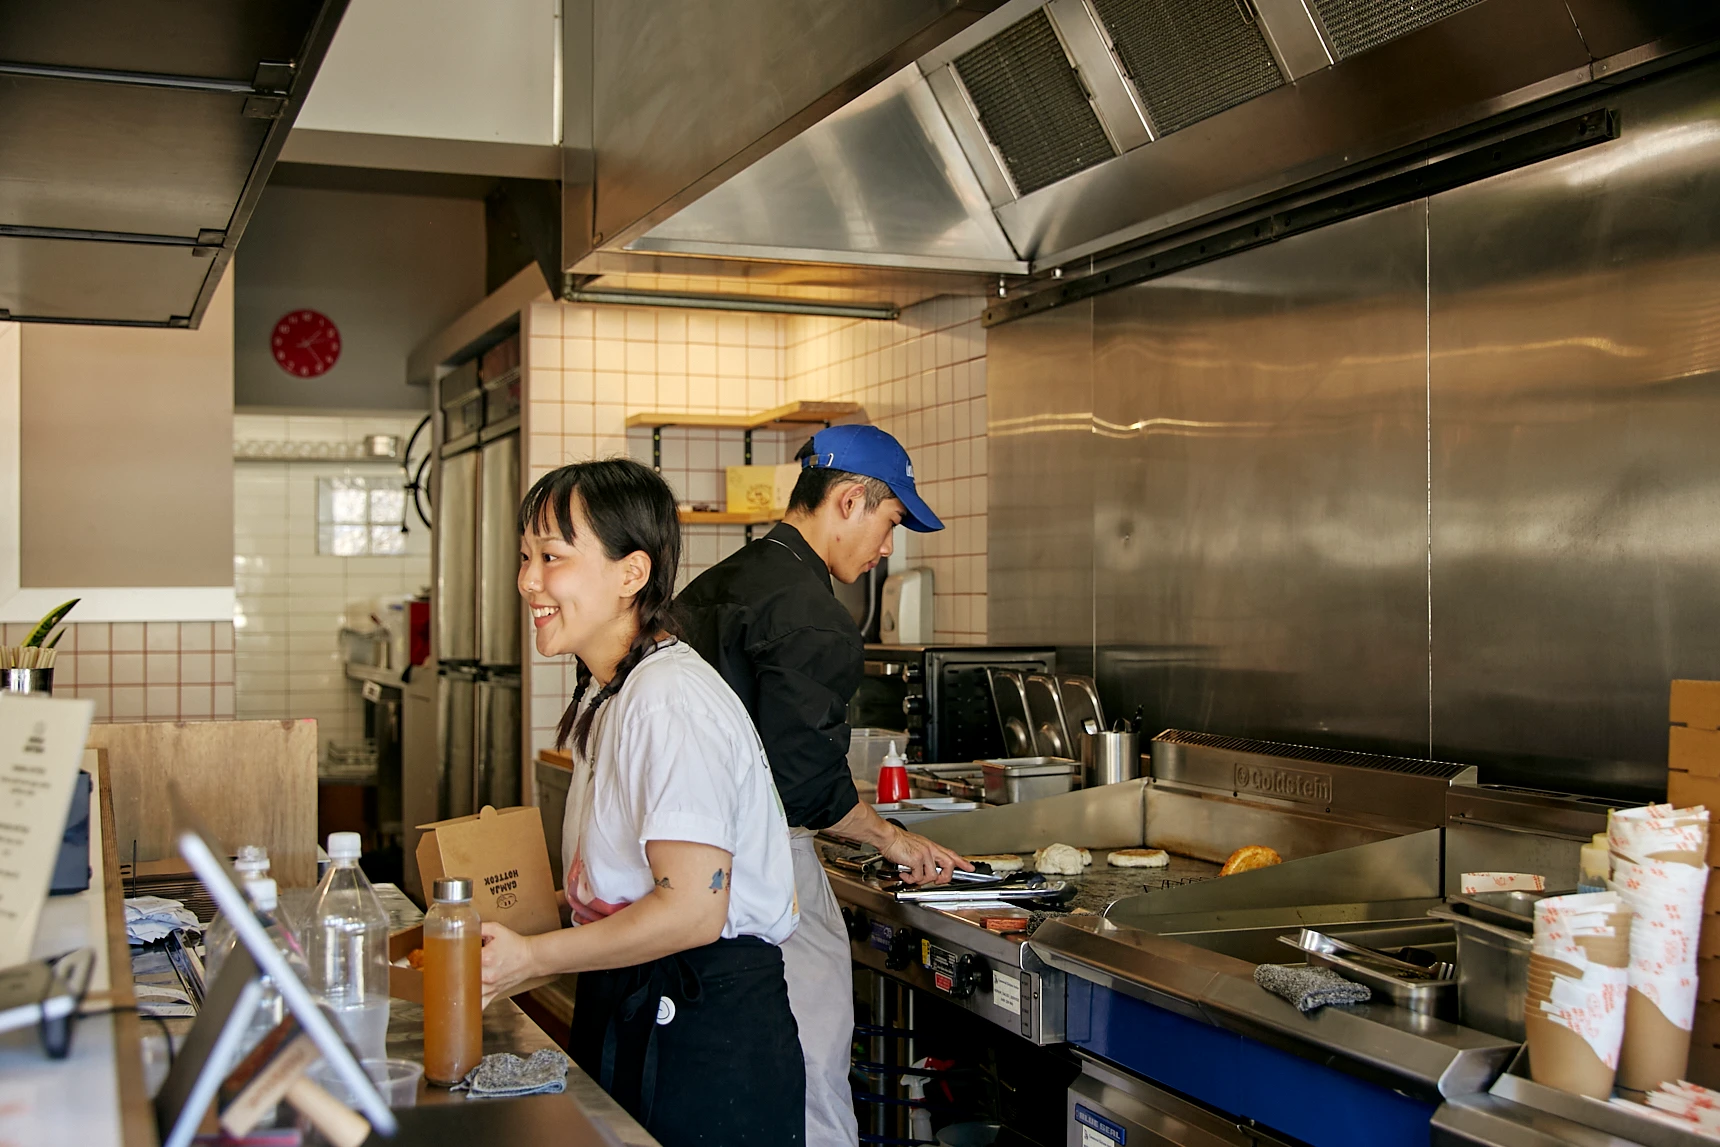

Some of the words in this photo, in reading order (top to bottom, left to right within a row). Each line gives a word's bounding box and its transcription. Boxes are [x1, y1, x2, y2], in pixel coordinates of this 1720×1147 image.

[1252, 769, 1329, 799] Goldstein
[483, 869, 519, 886] HOTTEOK
[489, 880, 517, 895] GAMJA
[1079, 1111, 1099, 1128] BLUE
[1100, 1122, 1121, 1140] SEAL
